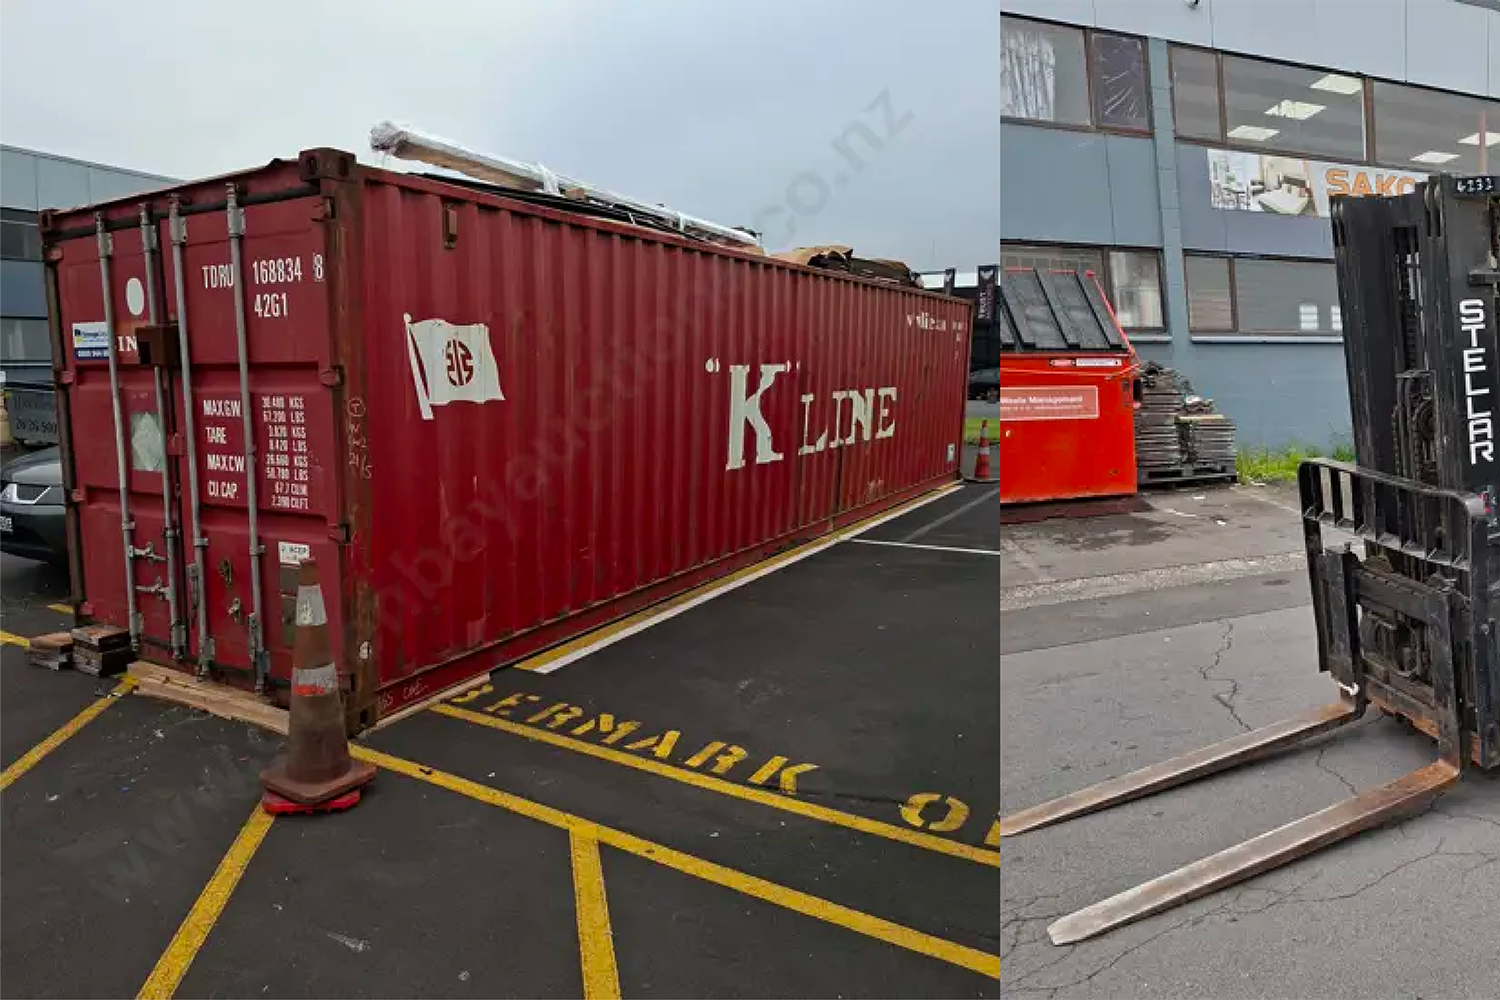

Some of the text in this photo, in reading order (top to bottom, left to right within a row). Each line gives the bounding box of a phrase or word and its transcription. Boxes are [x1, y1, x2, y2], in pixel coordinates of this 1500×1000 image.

[201, 253, 325, 289] TDRU 168834 8
[254, 292, 289, 317] 42G1
[1459, 299, 1495, 465] STELLAR
[205, 427, 227, 444] TARE
[798, 387, 897, 455] LINE
